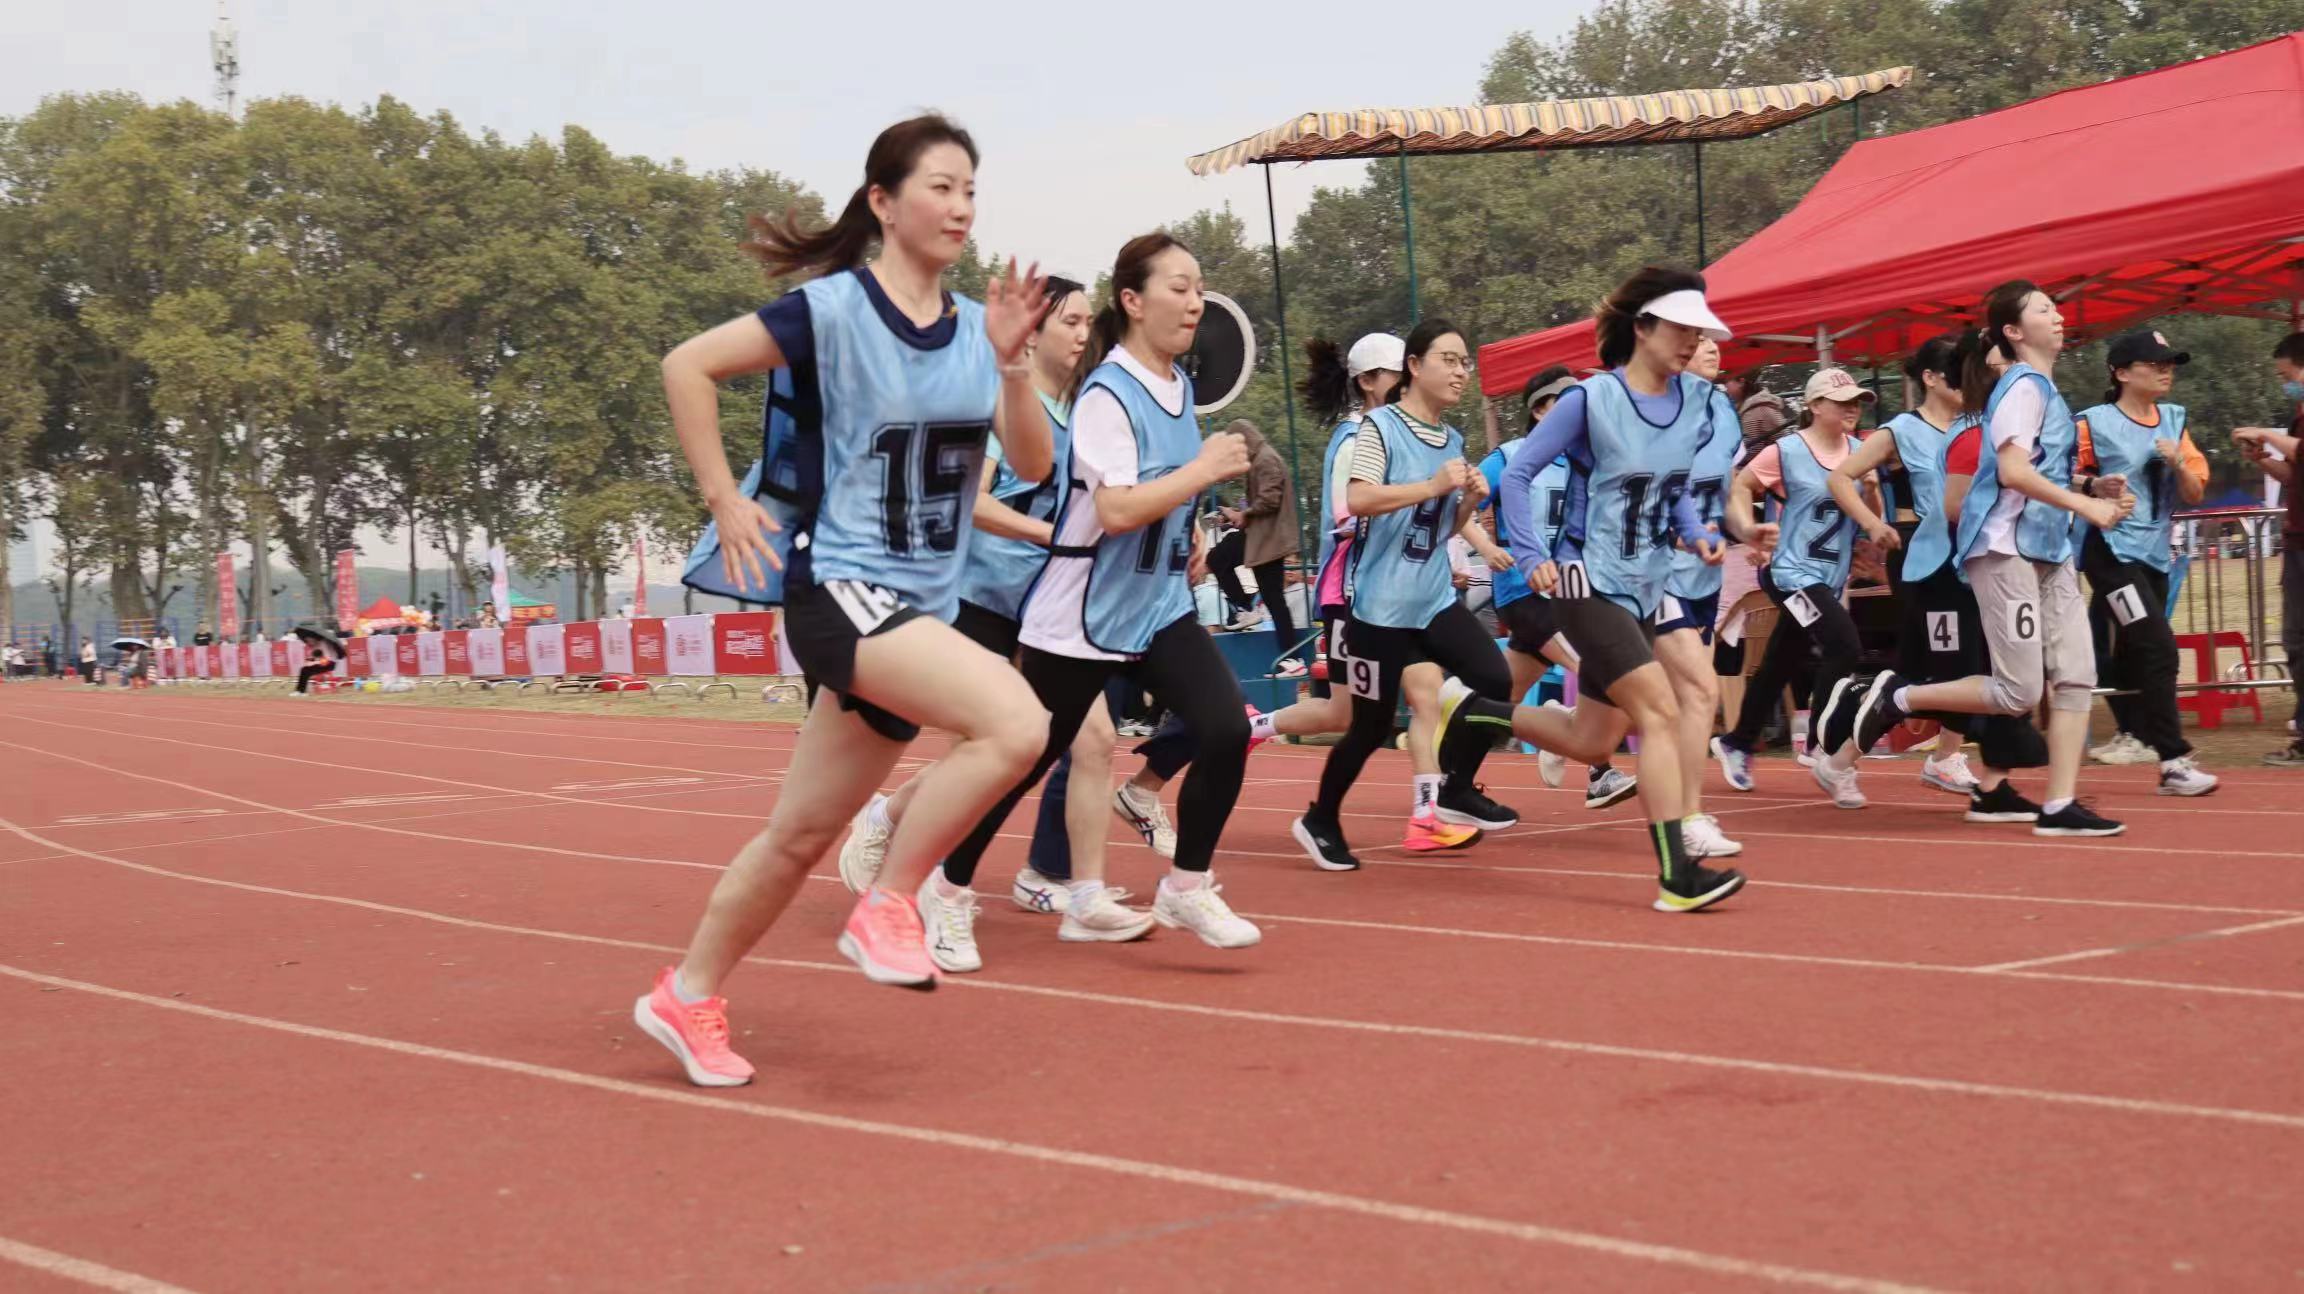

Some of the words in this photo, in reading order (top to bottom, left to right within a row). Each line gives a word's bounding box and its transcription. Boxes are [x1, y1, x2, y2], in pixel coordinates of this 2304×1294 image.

[870, 420, 993, 560] 15
[1805, 497, 1845, 565] 2
[2015, 602, 2035, 640] 6
[2115, 590, 2136, 621] 1
[1933, 613, 1952, 649] 4
[1353, 660, 1371, 696] 9
